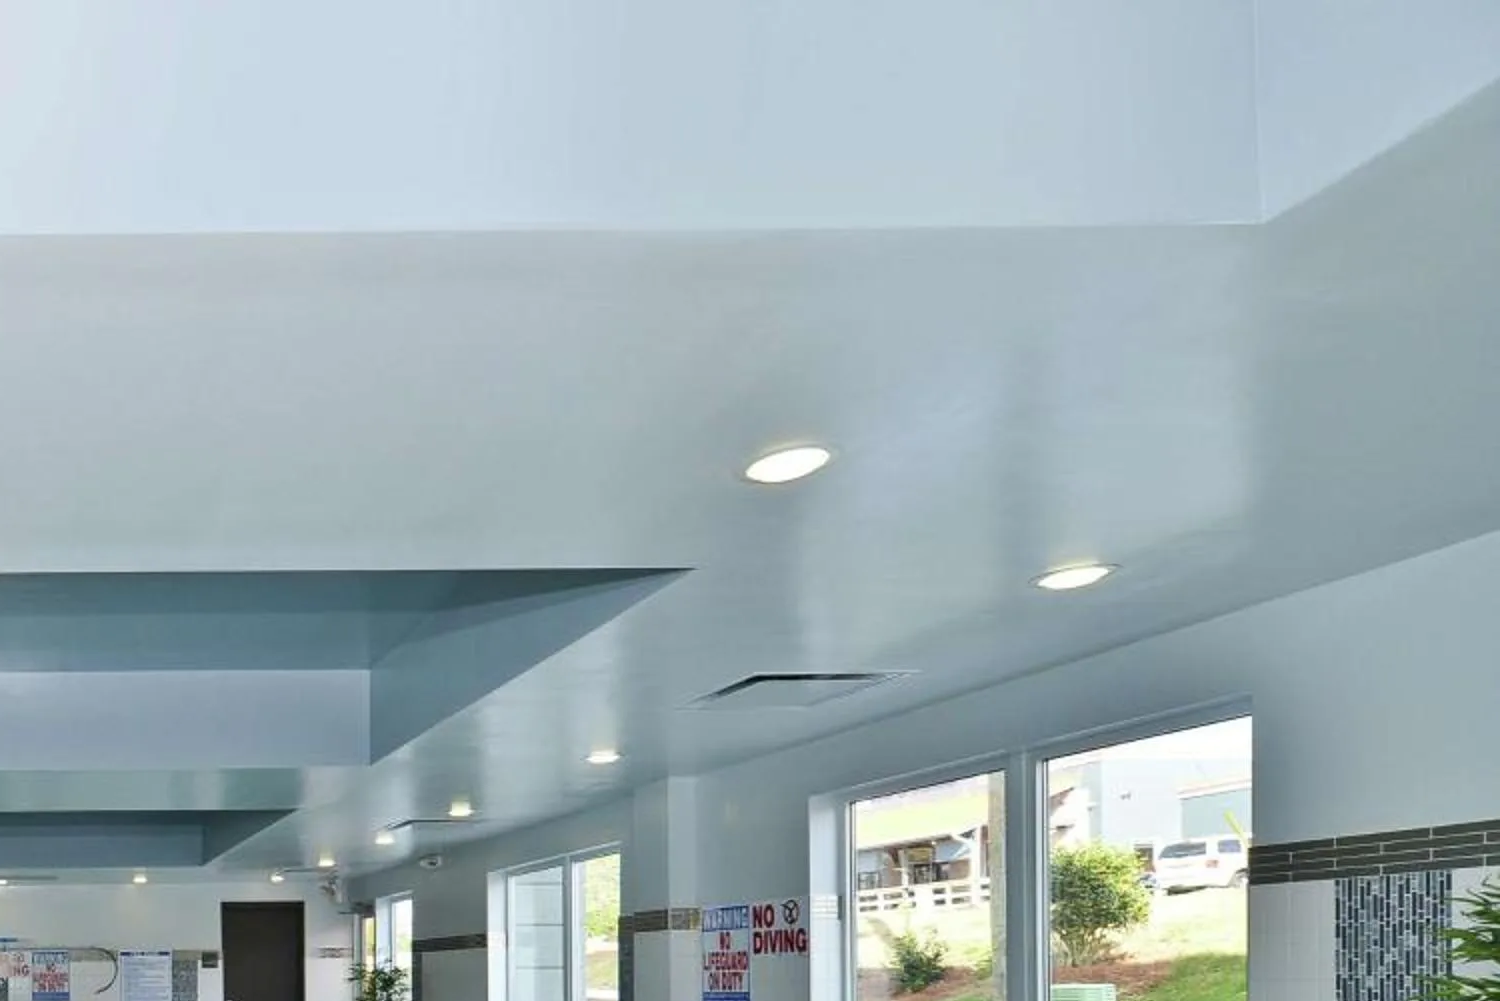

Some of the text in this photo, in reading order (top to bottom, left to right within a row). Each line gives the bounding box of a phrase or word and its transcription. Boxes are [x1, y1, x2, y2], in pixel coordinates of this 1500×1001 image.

[752, 904, 775, 928] NO
[719, 931, 731, 950] NO
[753, 928, 807, 954] DIVING
[704, 951, 748, 970] LIFEGUARD
[708, 971, 743, 990] ON DUTY
